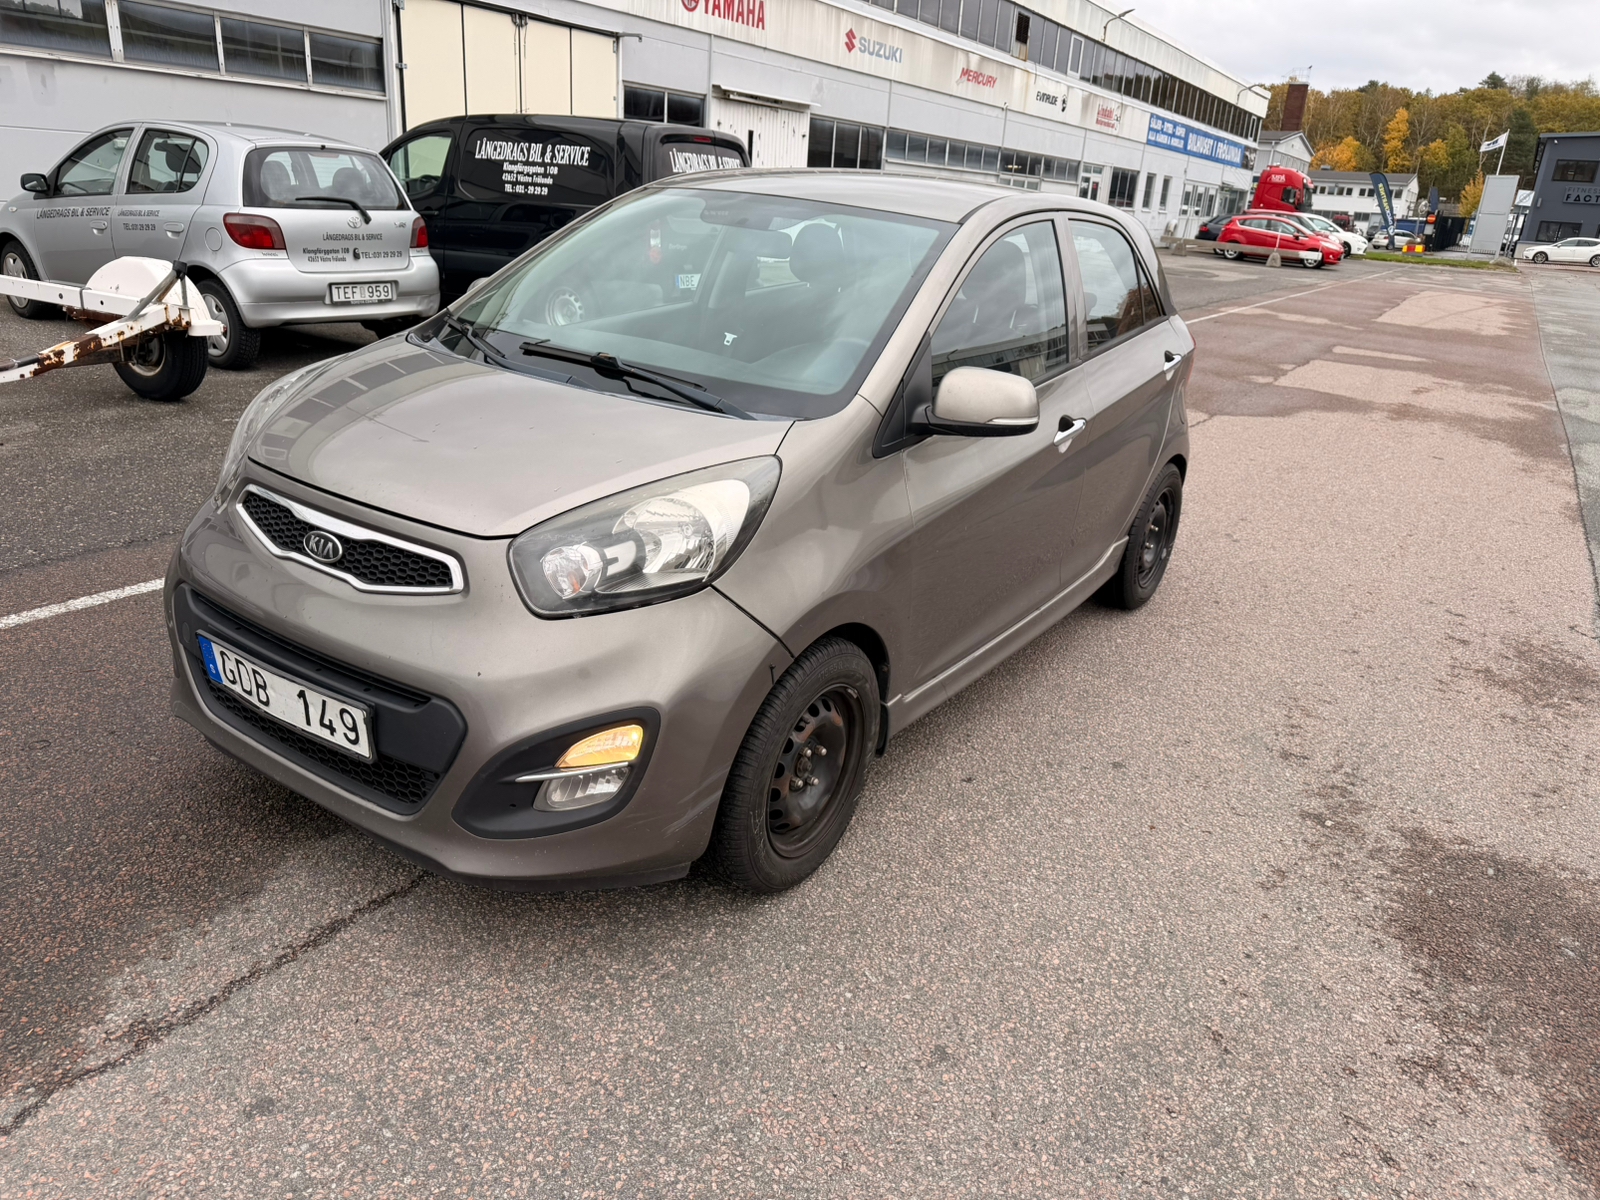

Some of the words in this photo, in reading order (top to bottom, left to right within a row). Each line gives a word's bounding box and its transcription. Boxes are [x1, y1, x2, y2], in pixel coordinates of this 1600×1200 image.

[858, 36, 903, 64] SUZUKI
[960, 67, 998, 89] MERCURY
[1036, 91, 1059, 107] EVINRUDE
[475, 137, 528, 161] LÅNGEDRAGS
[529, 143, 543, 162] BIL
[544, 144, 552, 163] &
[553, 144, 591, 166] SERVICE
[517, 174, 532, 183] Västra
[533, 175, 553, 184] Frölunda
[1565, 193, 1600, 203] FACT
[37, 208, 71, 219] LÅNGEDRAGS
[71, 208, 79, 218] BIL
[80, 208, 85, 217] &
[86, 207, 111, 216] SERVICE
[322, 232, 354, 241] LÅNGEDRAGS
[680, 275, 695, 287] NBE
[335, 286, 358, 299] TEF
[367, 285, 389, 298] 959
[309, 535, 333, 559] KIA
[220, 650, 270, 707] GDB
[297, 690, 359, 745] 149
